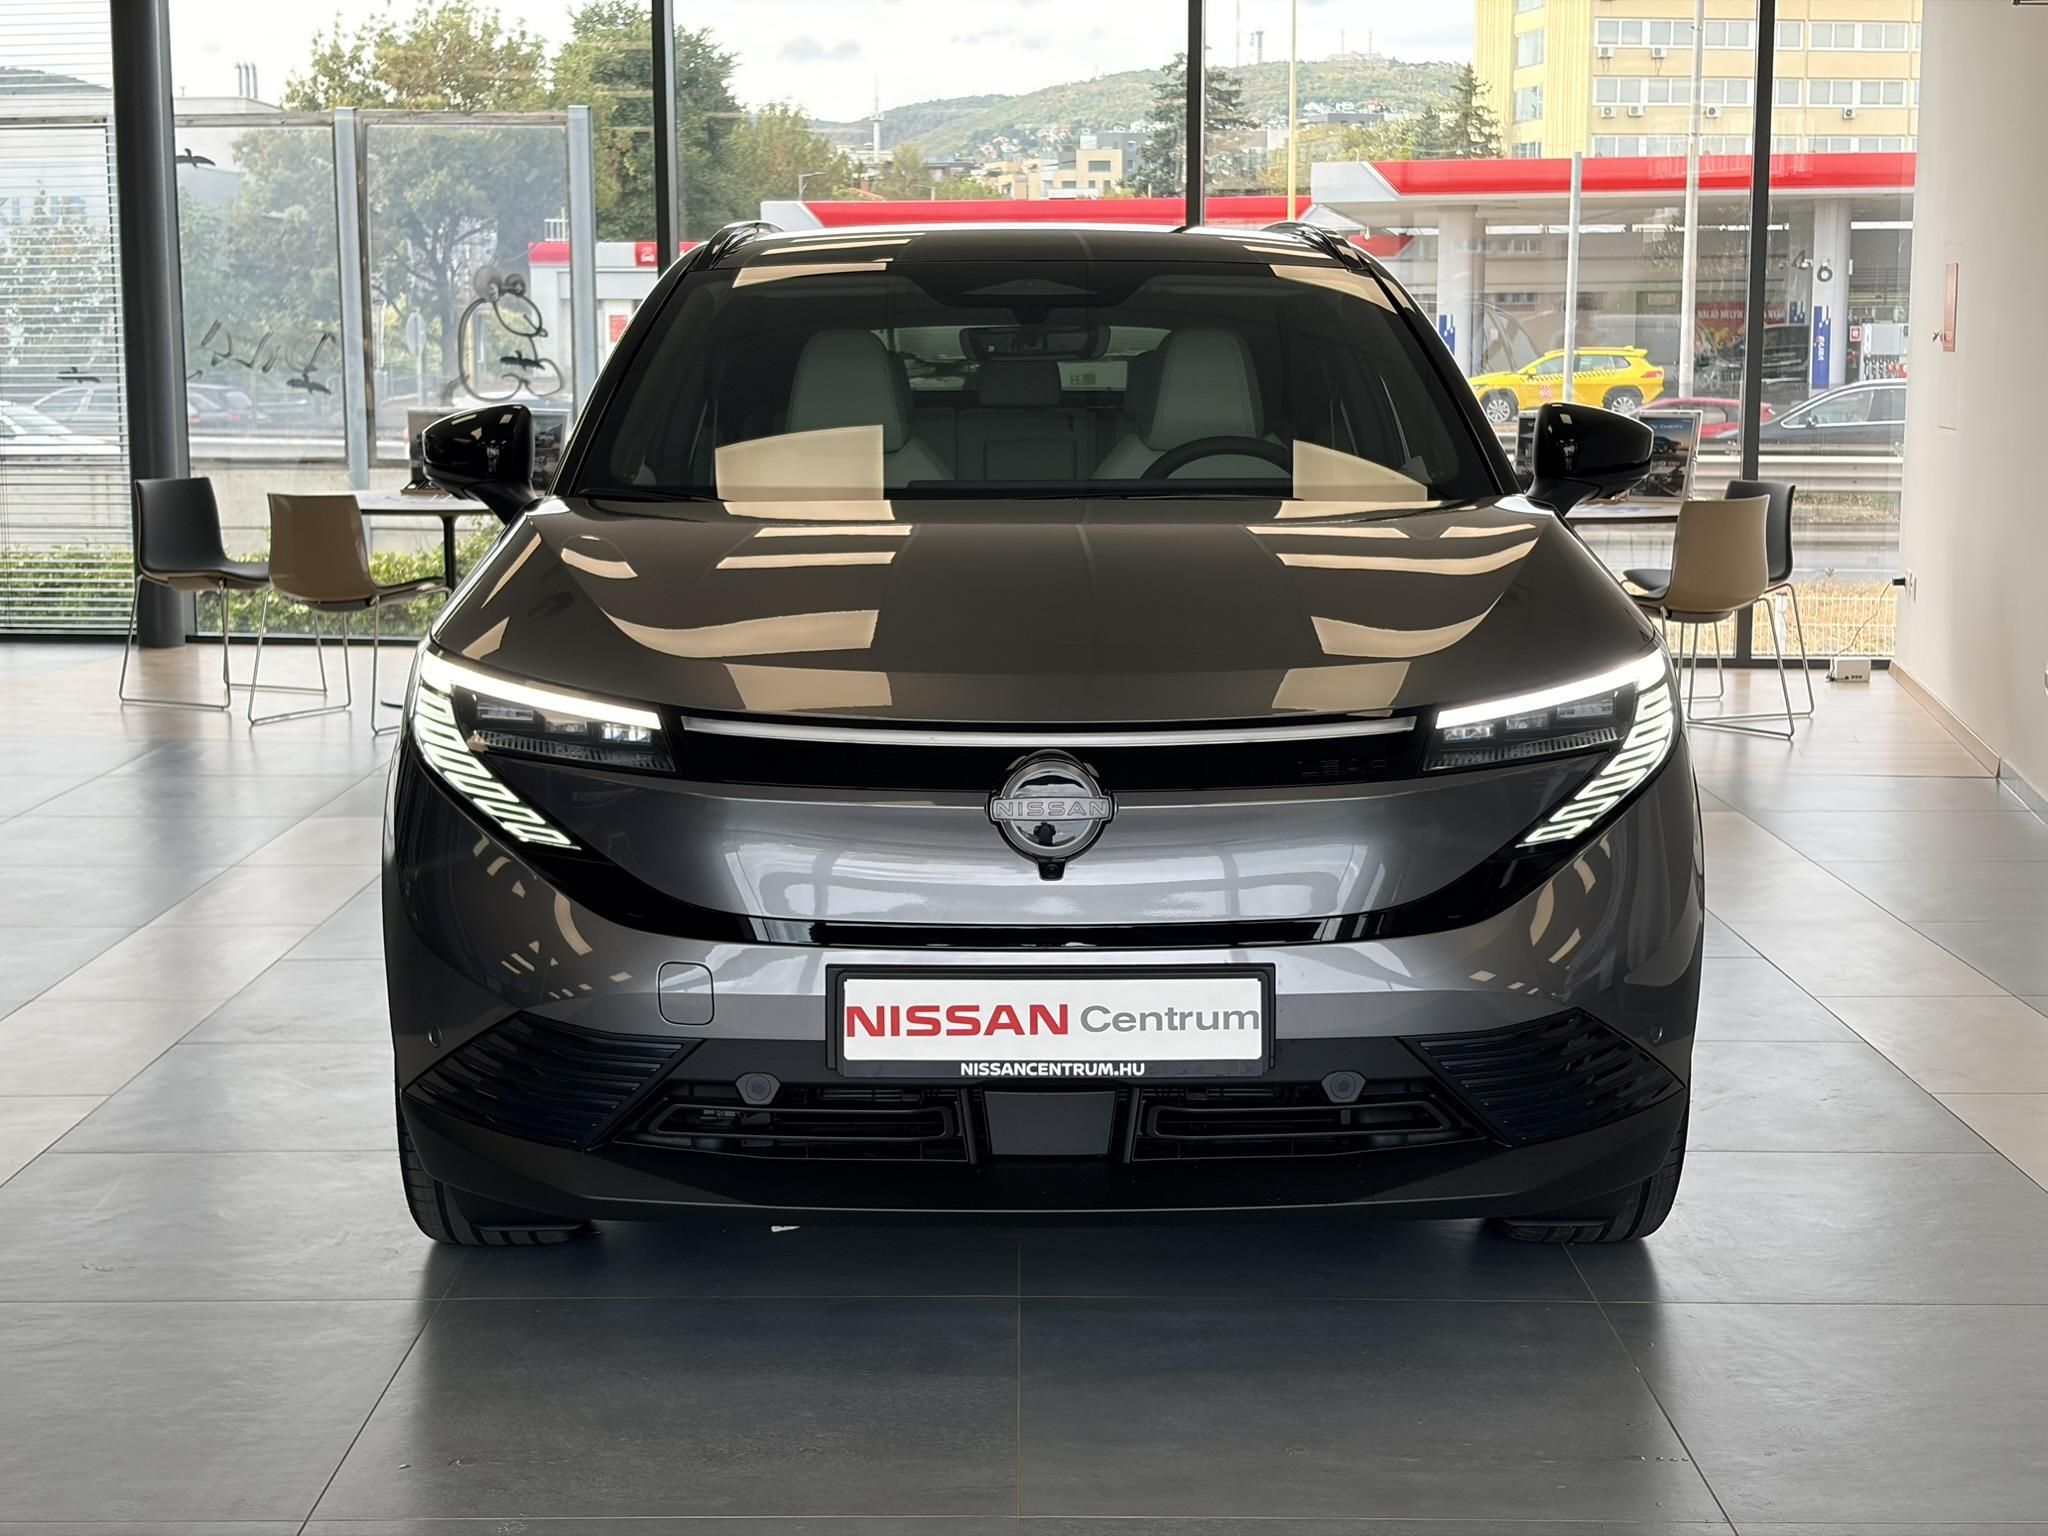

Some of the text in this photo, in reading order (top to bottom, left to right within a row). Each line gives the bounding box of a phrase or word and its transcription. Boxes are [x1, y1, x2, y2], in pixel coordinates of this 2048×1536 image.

[995, 801, 1108, 817] NISSAN
[846, 1003, 1260, 1037] NISSAN Centrum
[960, 1062, 1145, 1077] NISSANCENTRUM.HU
